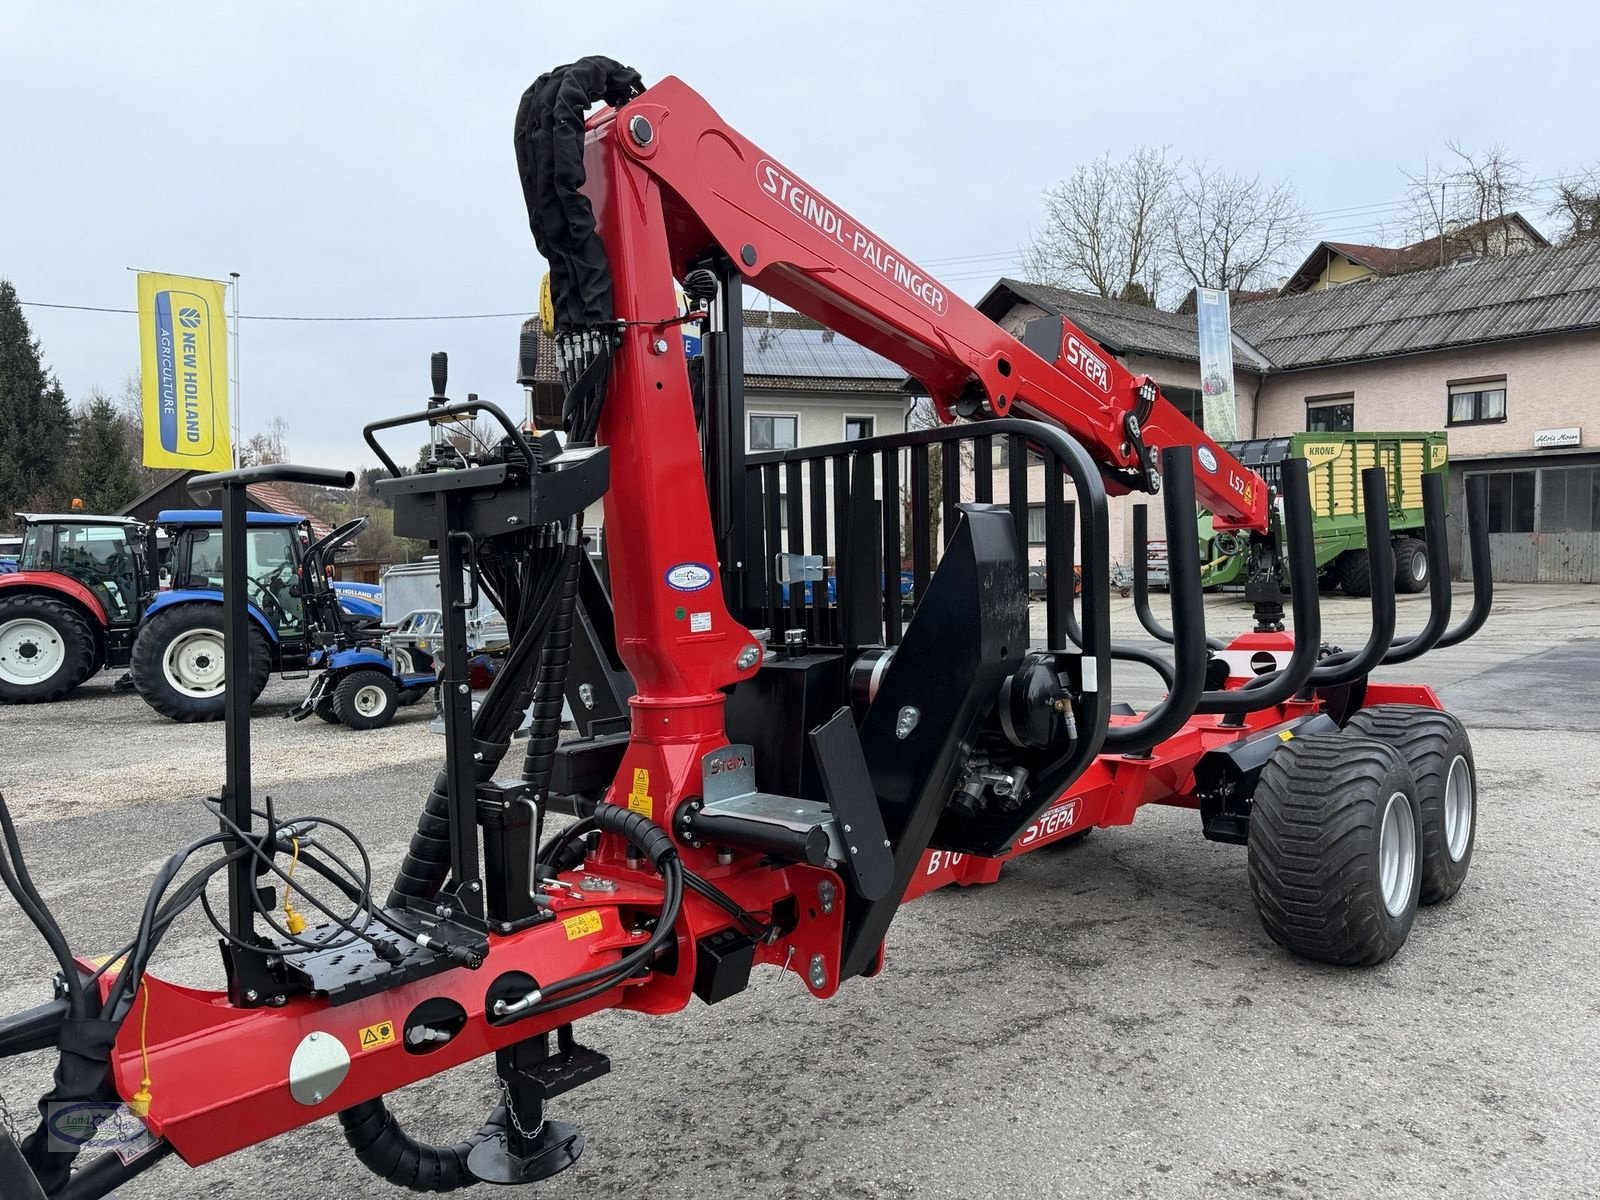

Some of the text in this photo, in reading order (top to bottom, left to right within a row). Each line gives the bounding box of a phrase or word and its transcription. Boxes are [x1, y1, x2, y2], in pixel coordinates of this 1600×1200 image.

[763, 166, 944, 312] STEINDL-PALFINGER
[160, 327, 175, 415] AGRICULTURE
[1067, 337, 1107, 391] STEPA
[183, 332, 200, 443] NEW HOLLAND
[1309, 446, 1335, 456] KRONE
[1229, 470, 1245, 495] L52
[342, 588, 372, 598] HOLLAND
[711, 756, 747, 775] STEPA
[1023, 807, 1074, 844] STEPA
